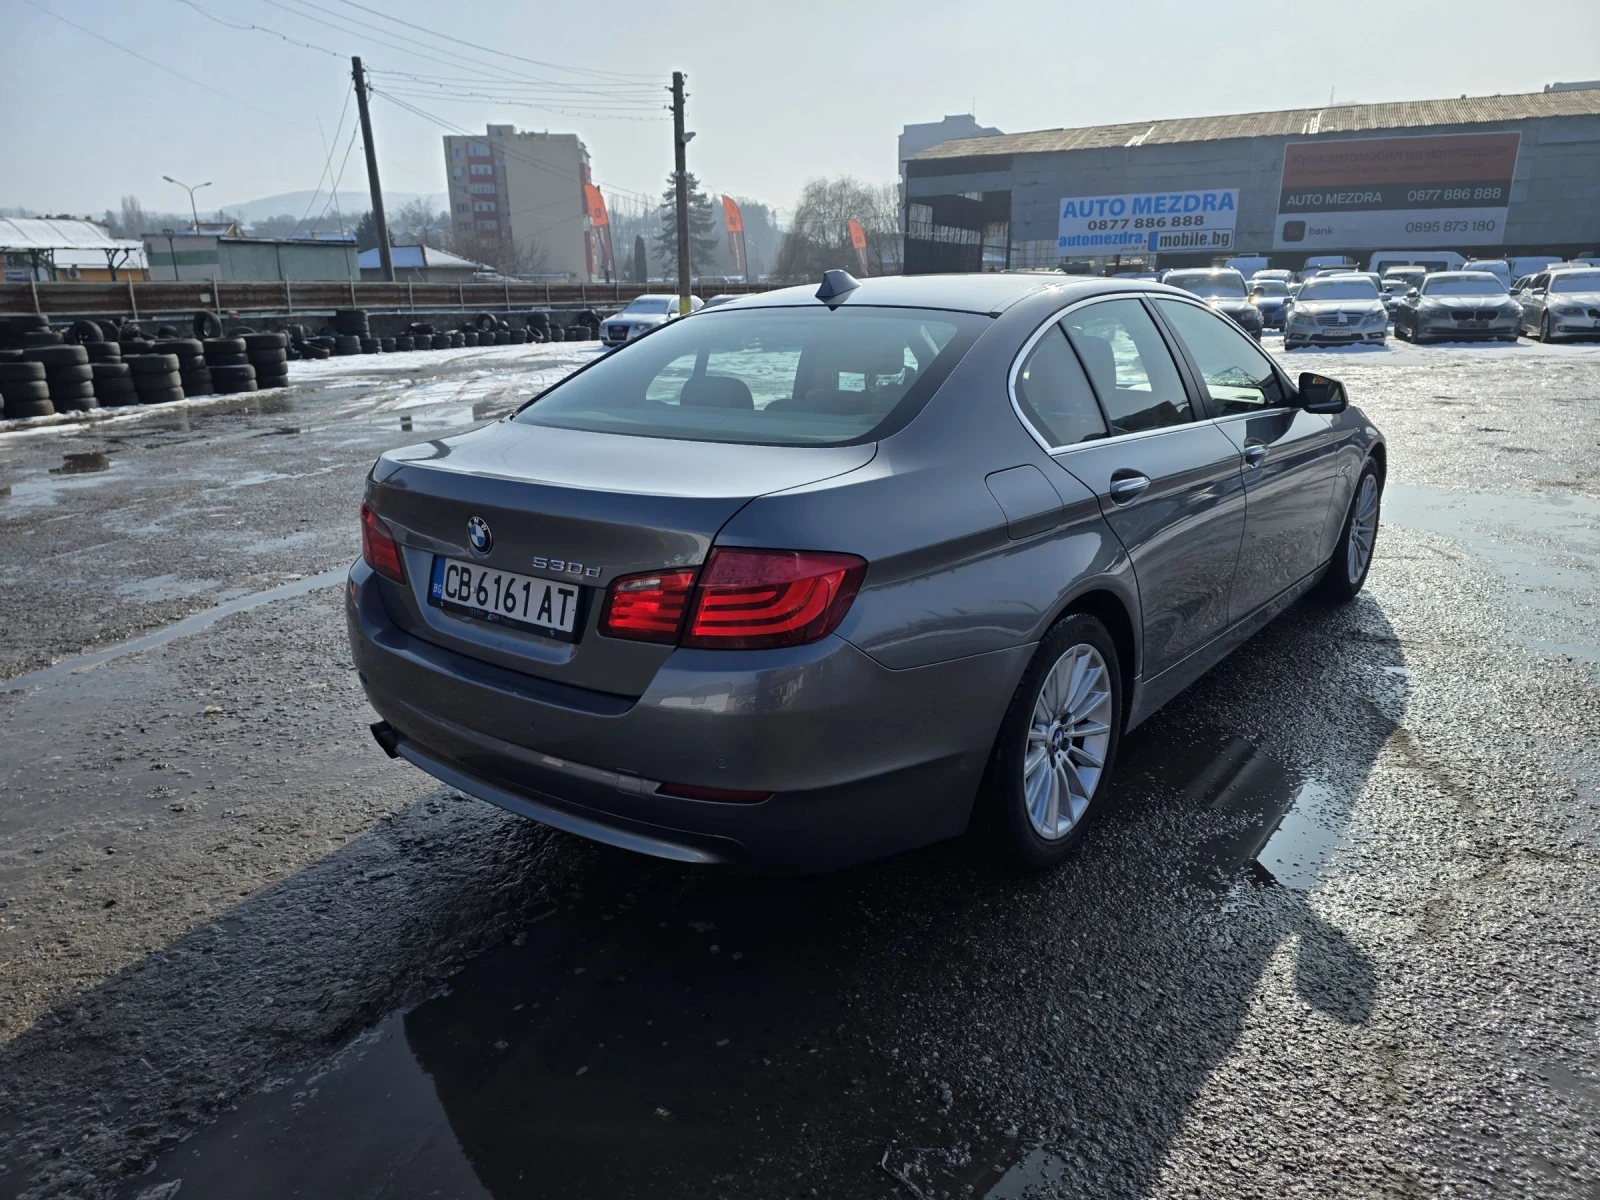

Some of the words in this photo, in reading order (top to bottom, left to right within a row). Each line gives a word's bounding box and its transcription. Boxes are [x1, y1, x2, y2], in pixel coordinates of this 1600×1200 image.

[1286, 193, 1324, 206] AUTO
[1325, 191, 1382, 205] MEZDRA
[1407, 189, 1441, 202] 0877
[1443, 188, 1470, 201] 886
[1473, 187, 1502, 200] 888
[1062, 197, 1125, 219] AUTO
[1131, 191, 1235, 215] MEZDRA
[1087, 219, 1130, 231] 0877
[1133, 217, 1167, 229] 886
[1170, 215, 1205, 227] 888
[1308, 226, 1334, 235] bank
[1405, 222, 1441, 234] 0895
[1442, 221, 1468, 233] 873
[1471, 219, 1496, 232] 180
[1159, 231, 1230, 248] mobile.bg
[532, 556, 603, 578] 530d
